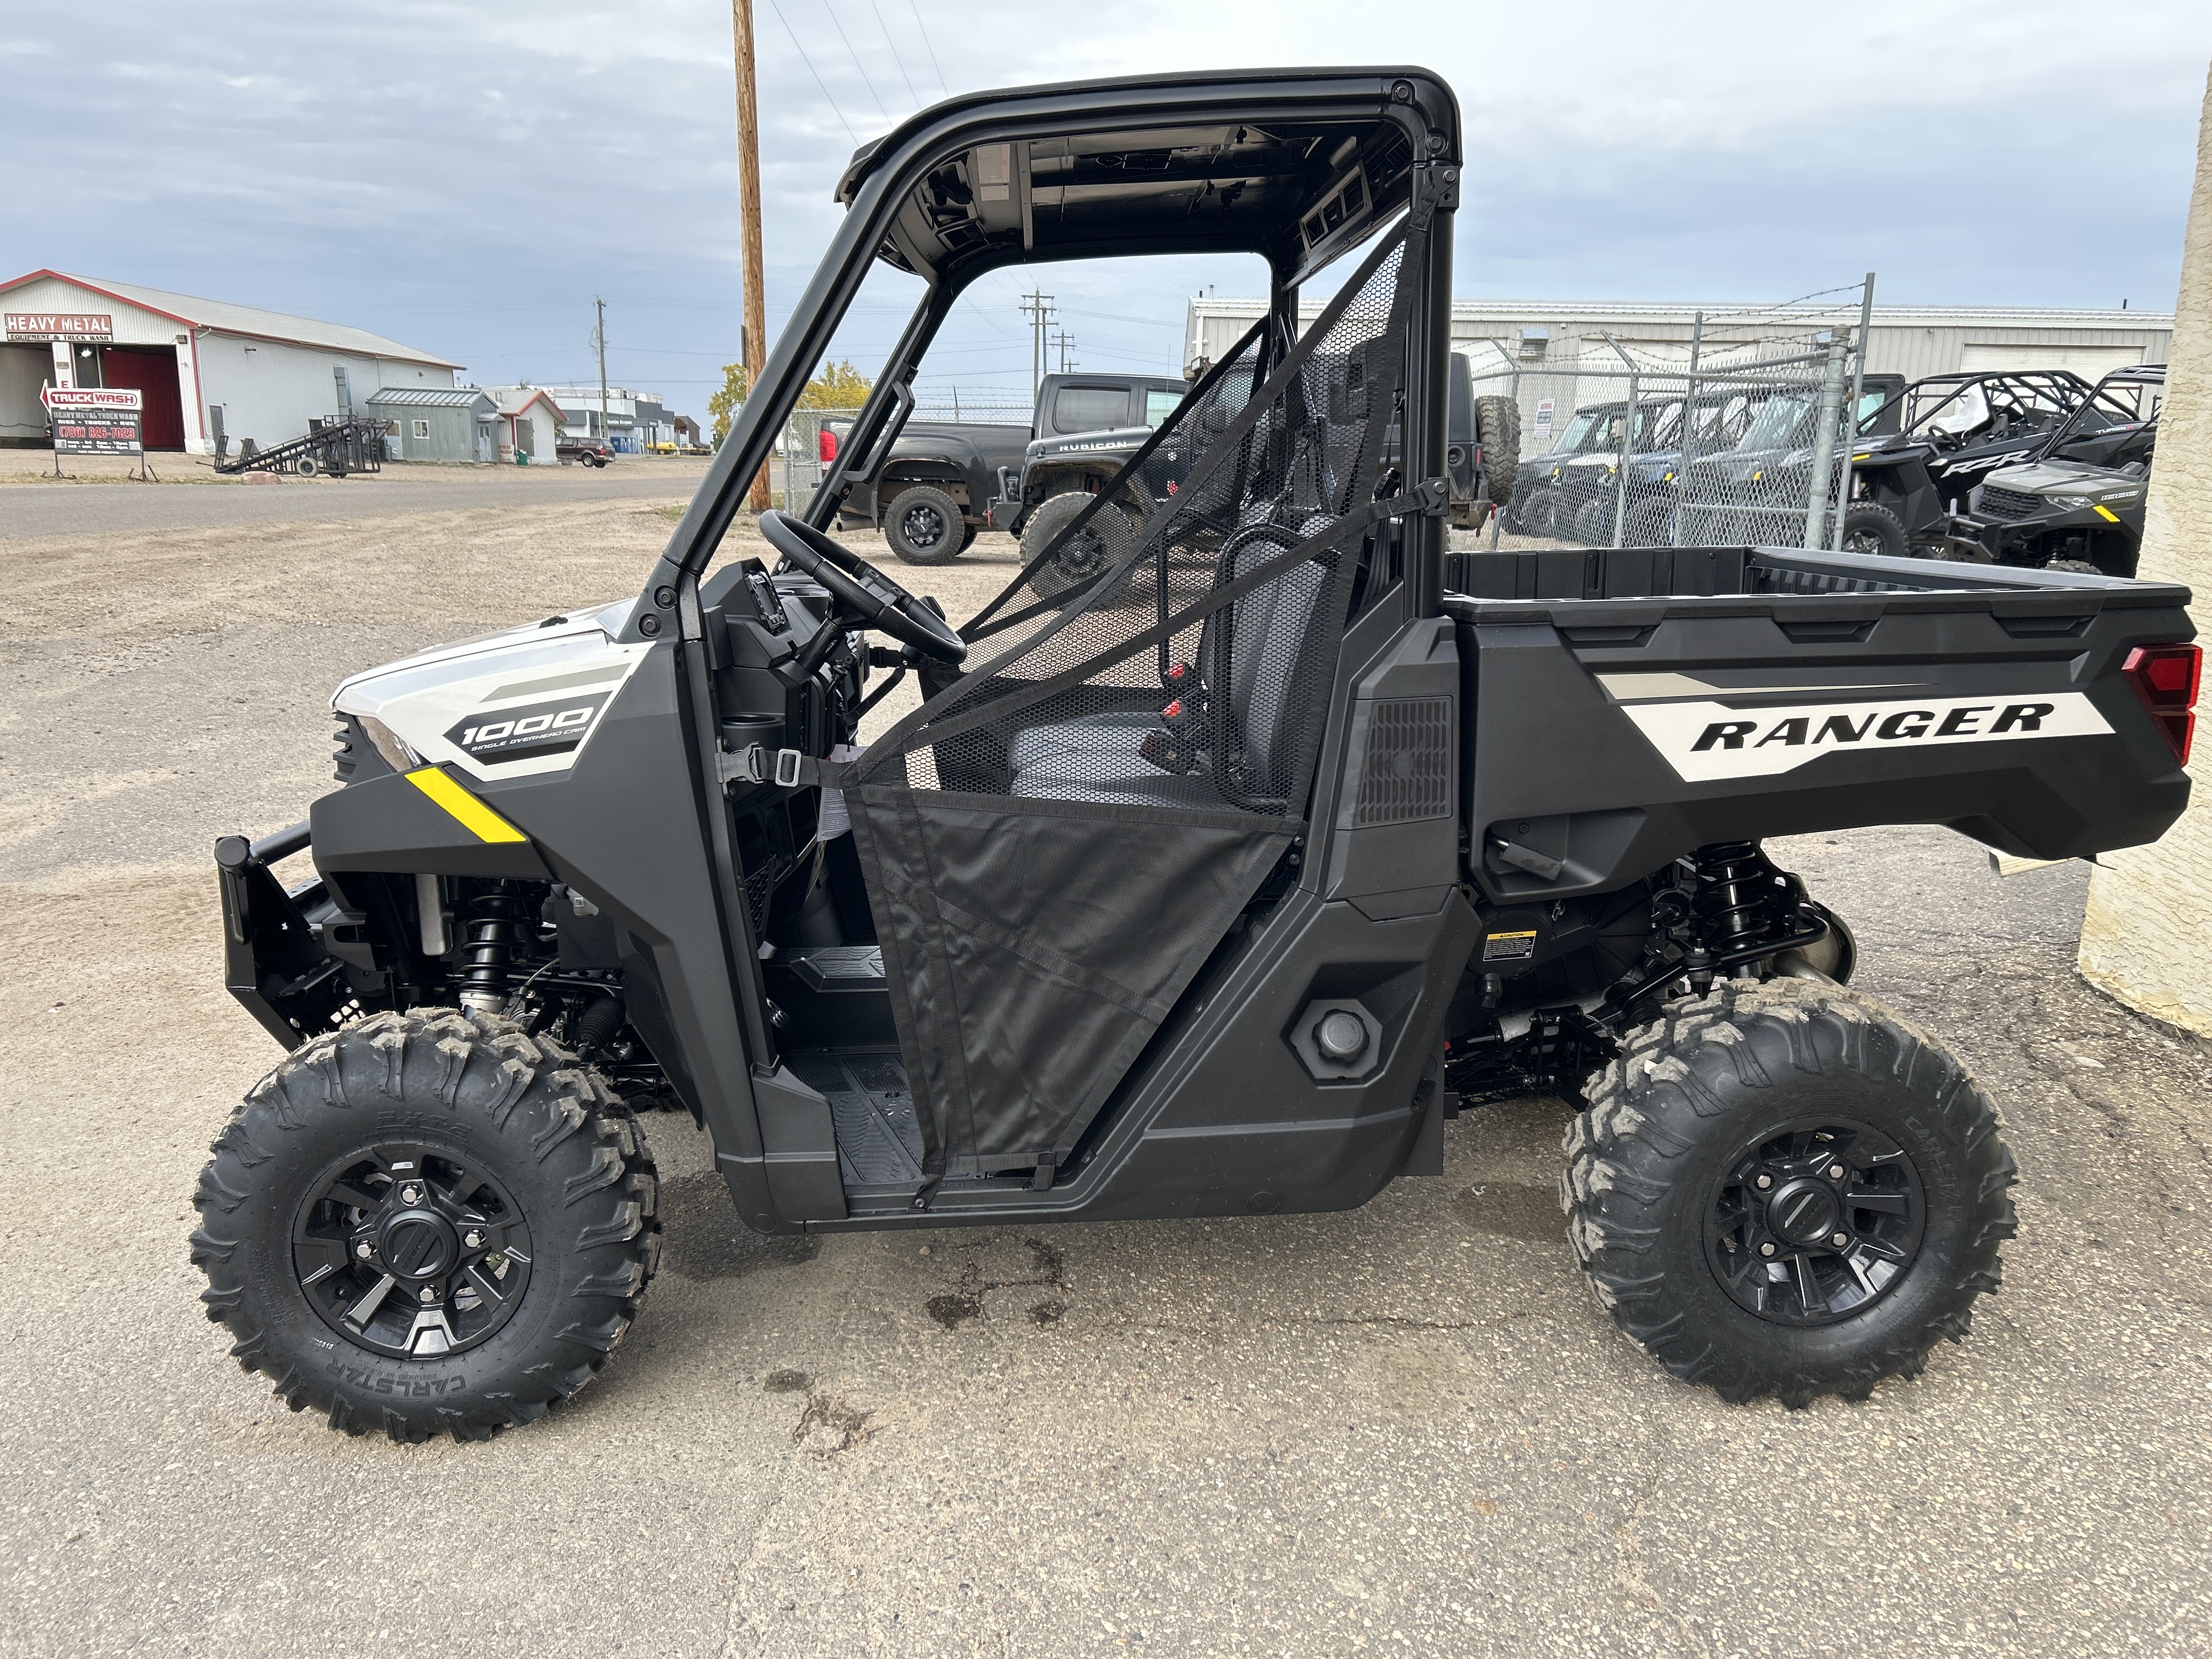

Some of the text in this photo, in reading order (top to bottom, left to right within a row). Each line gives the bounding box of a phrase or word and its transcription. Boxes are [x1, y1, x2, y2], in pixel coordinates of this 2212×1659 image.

[7, 316, 110, 331] HEAVY METAL
[52, 393, 134, 404] TRUCK WASH
[75, 411, 96, 420] METAL
[59, 426, 135, 439] (780) 826-7023
[1059, 441, 1127, 452] RUBICON
[1939, 449, 2030, 479] RZR
[2101, 490, 2139, 501] 1000
[461, 707, 594, 746] 1000
[1689, 703, 2055, 752] RANGER
[471, 726, 587, 752] SINGLE OVERHEAD CAM
[325, 1358, 466, 1397] CARLSTAR
